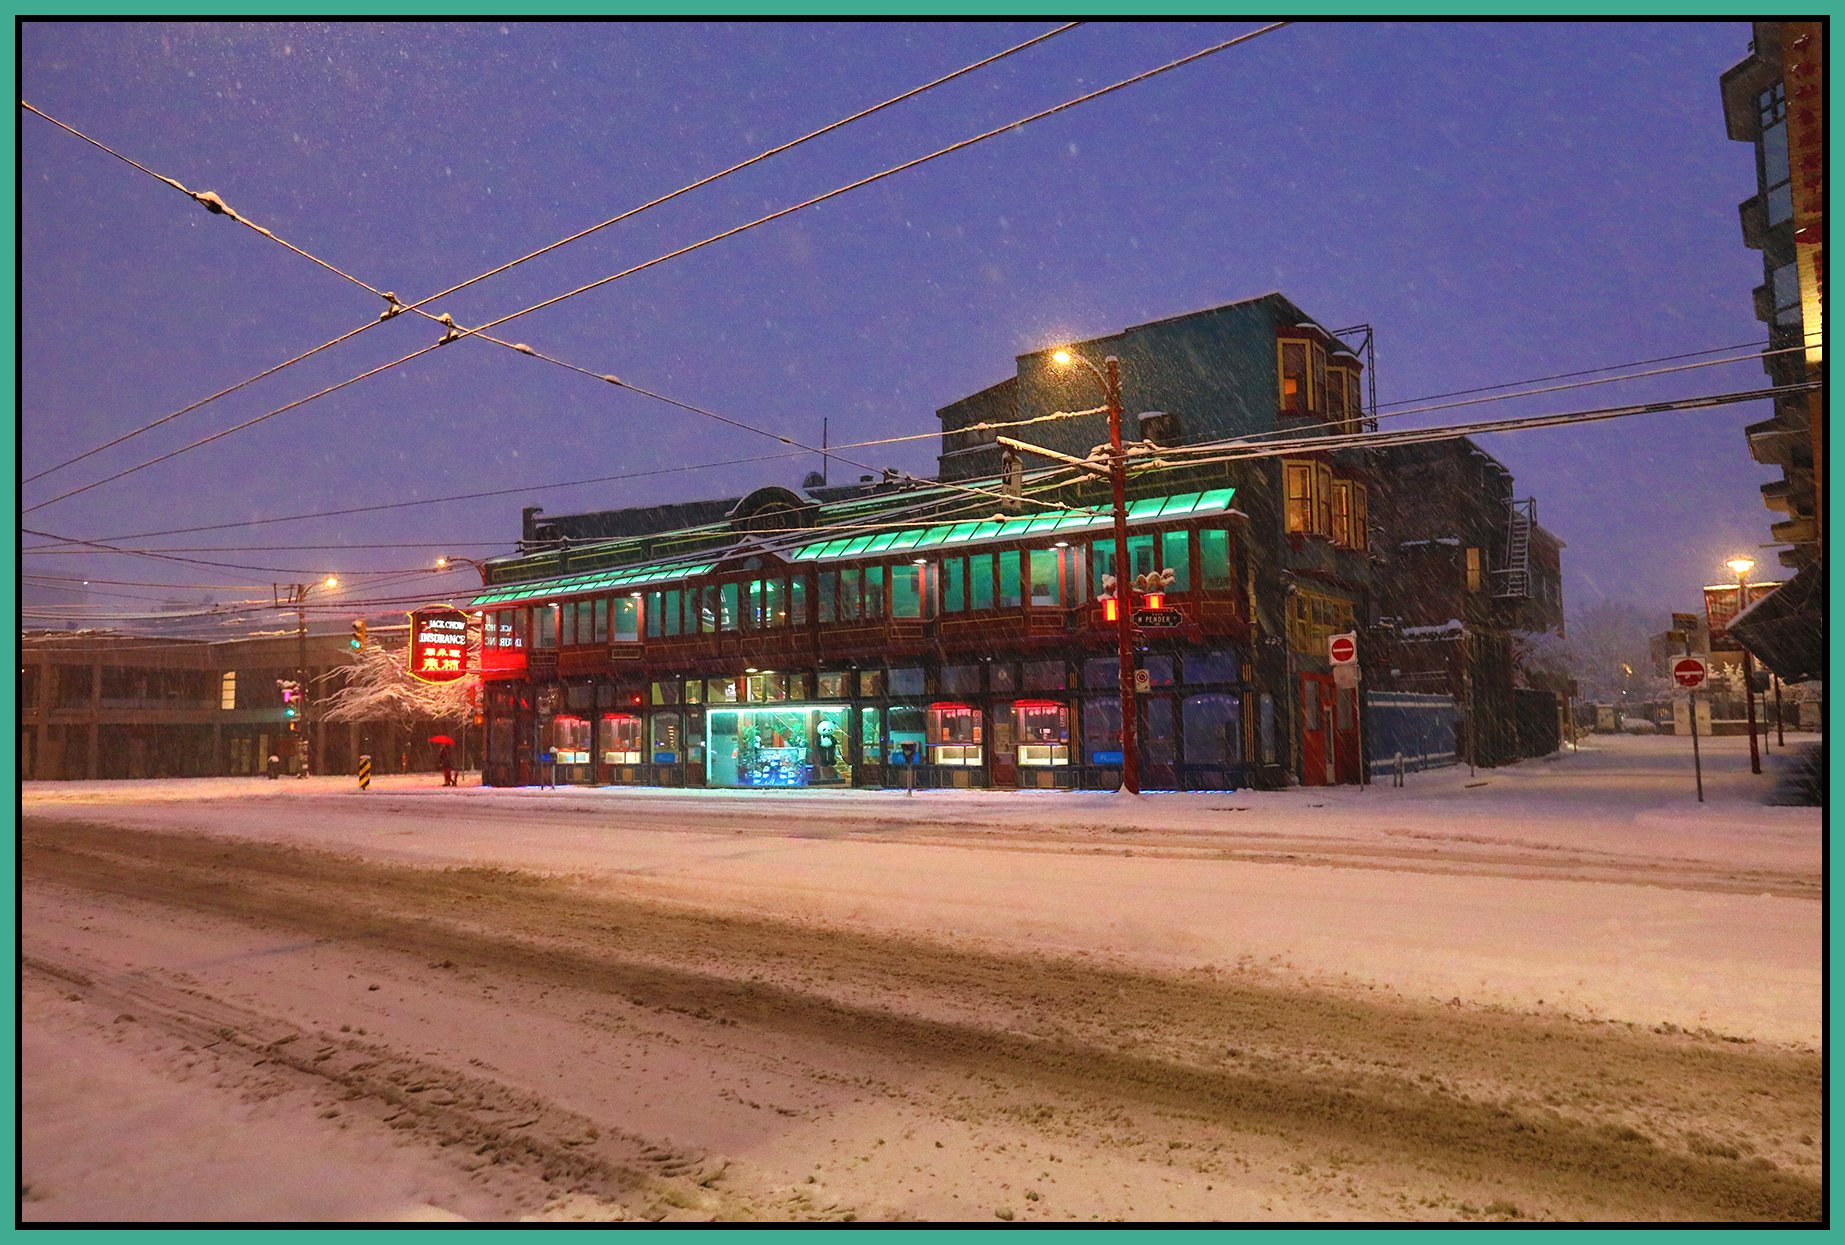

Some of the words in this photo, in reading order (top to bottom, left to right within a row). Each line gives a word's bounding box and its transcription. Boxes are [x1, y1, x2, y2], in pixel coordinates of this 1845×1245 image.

[426, 619, 445, 629] JACK
[445, 620, 466, 630] CHOW
[418, 632, 467, 645] INSURANCE
